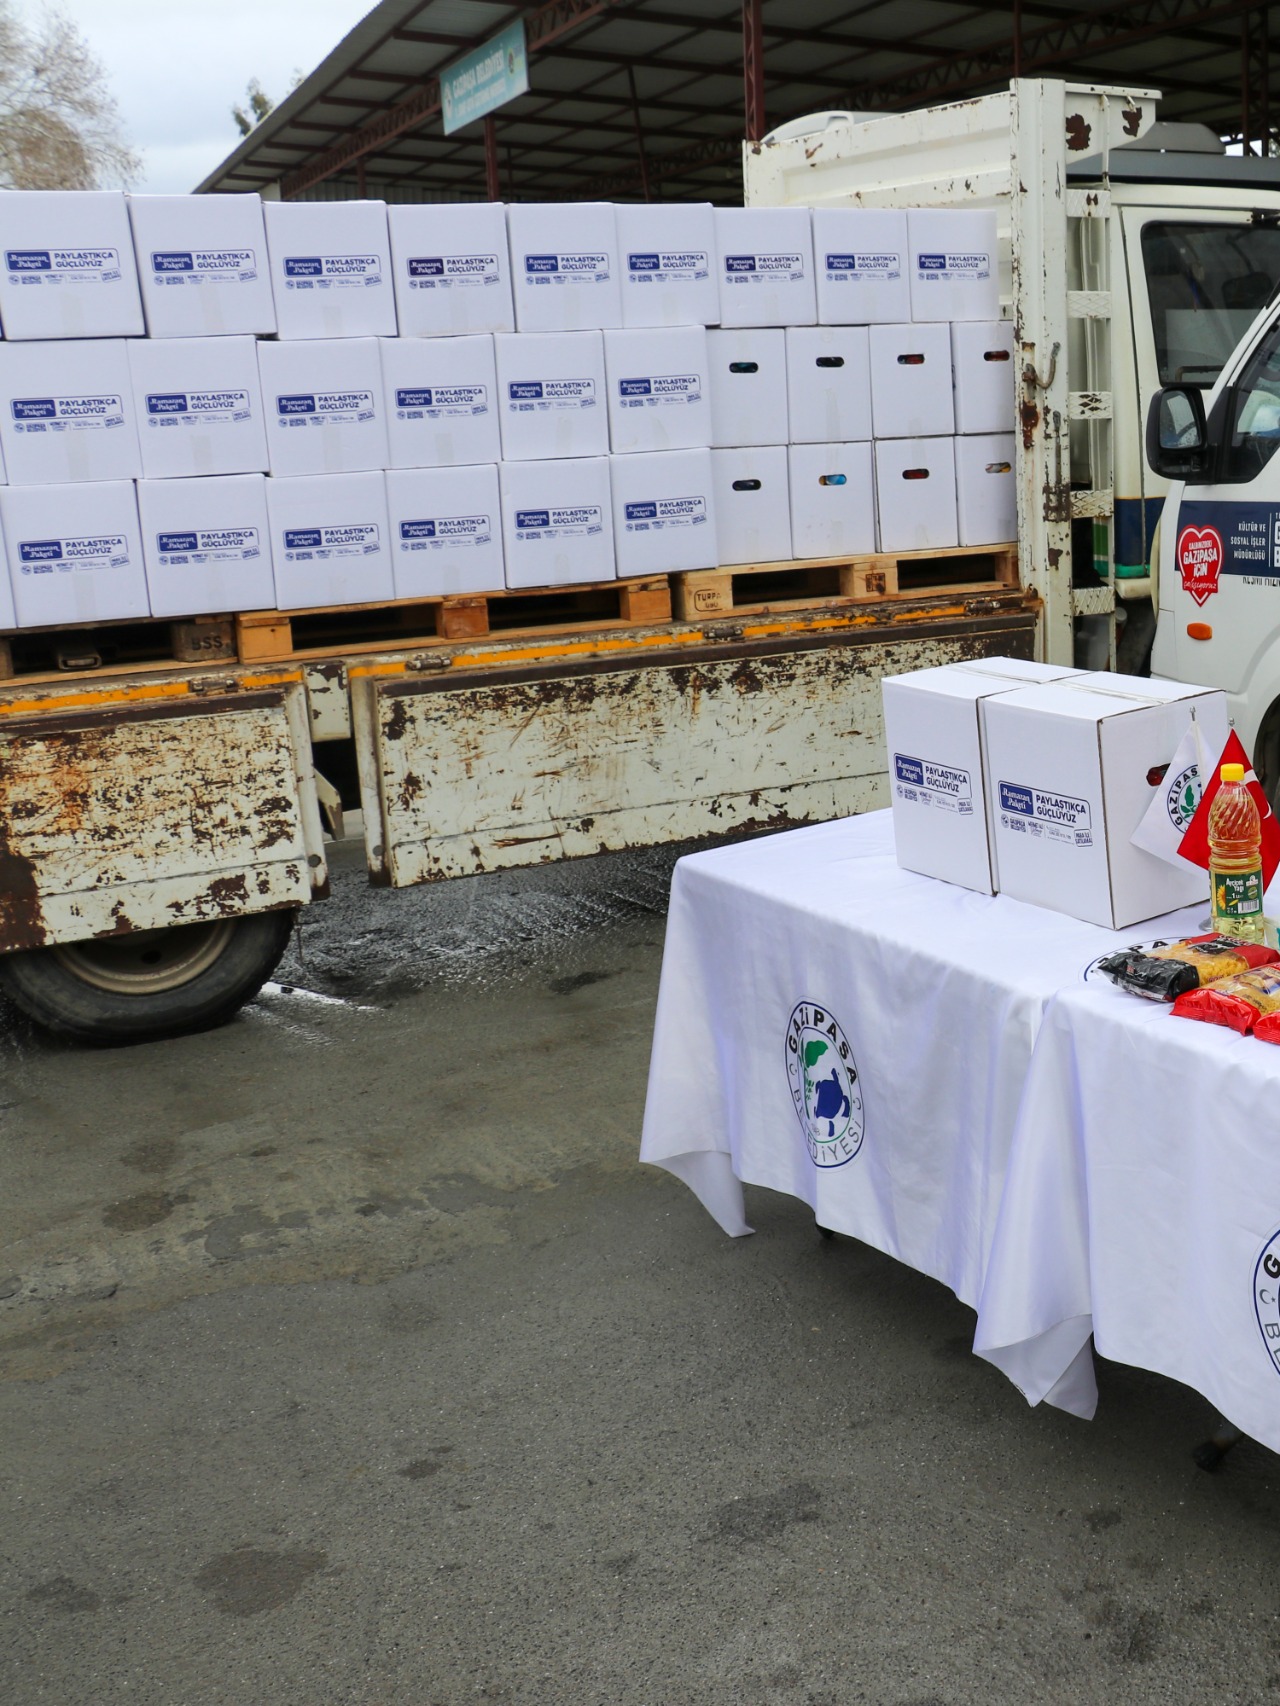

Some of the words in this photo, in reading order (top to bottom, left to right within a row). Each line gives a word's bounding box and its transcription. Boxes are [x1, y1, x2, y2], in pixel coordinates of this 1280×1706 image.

[1238, 521, 1258, 532] KÜLTÜR
[1259, 524, 1266, 532] VE
[1230, 537, 1249, 546] SOSYAL
[1250, 536, 1266, 547] İŞLER
[1183, 548, 1218, 565] GAZİPAŞA
[1193, 563, 1208, 578] İÇİN
[924, 764, 966, 784] PAYLAŞTIKÇA
[925, 774, 959, 793] GÜÇLÜYÜZ
[1002, 787, 1031, 805] Ramazan
[1007, 797, 1026, 810] Paketi
[1035, 793, 1085, 814] PAYLAŞTIKÇA
[1036, 804, 1076, 824] GÜÇLÜYÜZ
